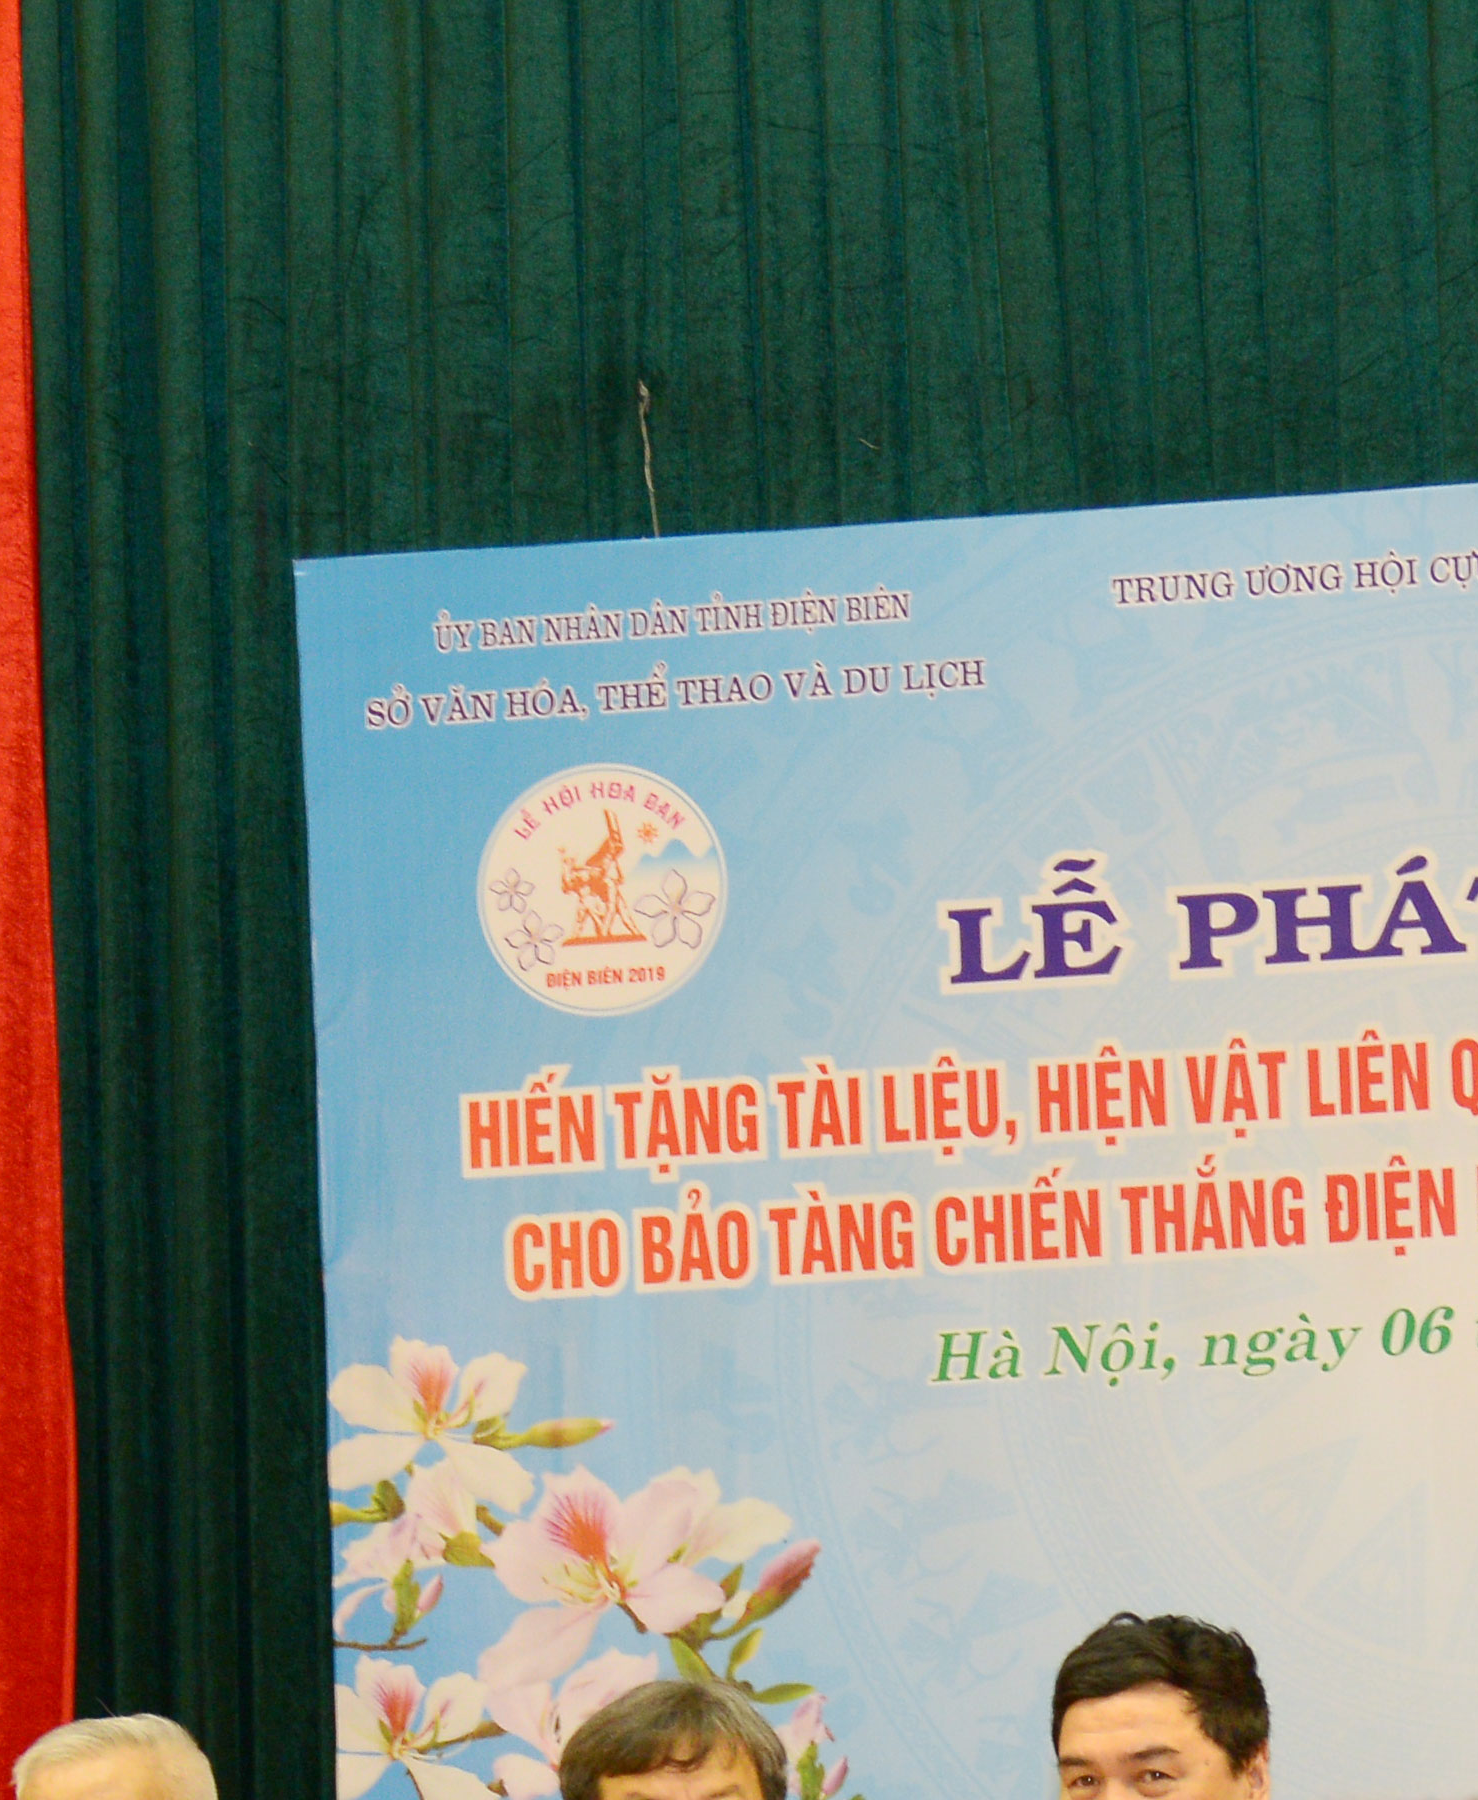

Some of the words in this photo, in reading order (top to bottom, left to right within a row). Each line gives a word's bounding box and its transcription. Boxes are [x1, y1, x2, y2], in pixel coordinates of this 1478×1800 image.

[1114, 571, 1233, 603] TRUNG
[1246, 563, 1344, 595] ƯƠNG
[1354, 549, 1418, 594] HỘI
[435, 610, 471, 651] ỦY
[481, 619, 536, 648] BAN
[544, 604, 622, 643] NHÂN
[630, 600, 687, 637] DÂN
[696, 590, 763, 632] TỈNH
[771, 588, 838, 632] ĐIỆN
[845, 584, 910, 623] BIÊN
[368, 684, 411, 727] SỞ
[422, 684, 497, 721] VĂN
[506, 679, 587, 719] HÓA,
[598, 662, 668, 712] THỂ
[677, 673, 773, 705] THAO
[784, 661, 831, 697] VÀ
[844, 666, 891, 692] DU
[903, 661, 986, 697] LỊCH
[948, 858, 1121, 984] LỄ
[547, 969, 582, 989] ĐIỆN
[587, 967, 622, 985] BIÊN
[629, 966, 665, 982] 2019
[469, 1066, 597, 1171] HIẾN
[615, 1067, 758, 1172] TẶNG
[777, 1062, 863, 1151] TÀI
[882, 1057, 1017, 1153] LIỆU,
[1037, 1048, 1166, 1148] HIỆN
[1186, 1036, 1283, 1138] VẬT
[1307, 1031, 1429, 1116] LIÊN
[512, 1217, 620, 1292] CHO
[641, 1187, 749, 1284] BẢO
[769, 1187, 914, 1274] TÀNG
[935, 1167, 1102, 1269] CHIẾN
[1120, 1153, 1306, 1253] THẮNG
[1325, 1156, 1457, 1256] ĐIỆN
[931, 1327, 1022, 1383] Hà
[1042, 1322, 1178, 1390] Nội,
[1197, 1311, 1363, 1374] ngày
[1381, 1305, 1453, 1357] 06
